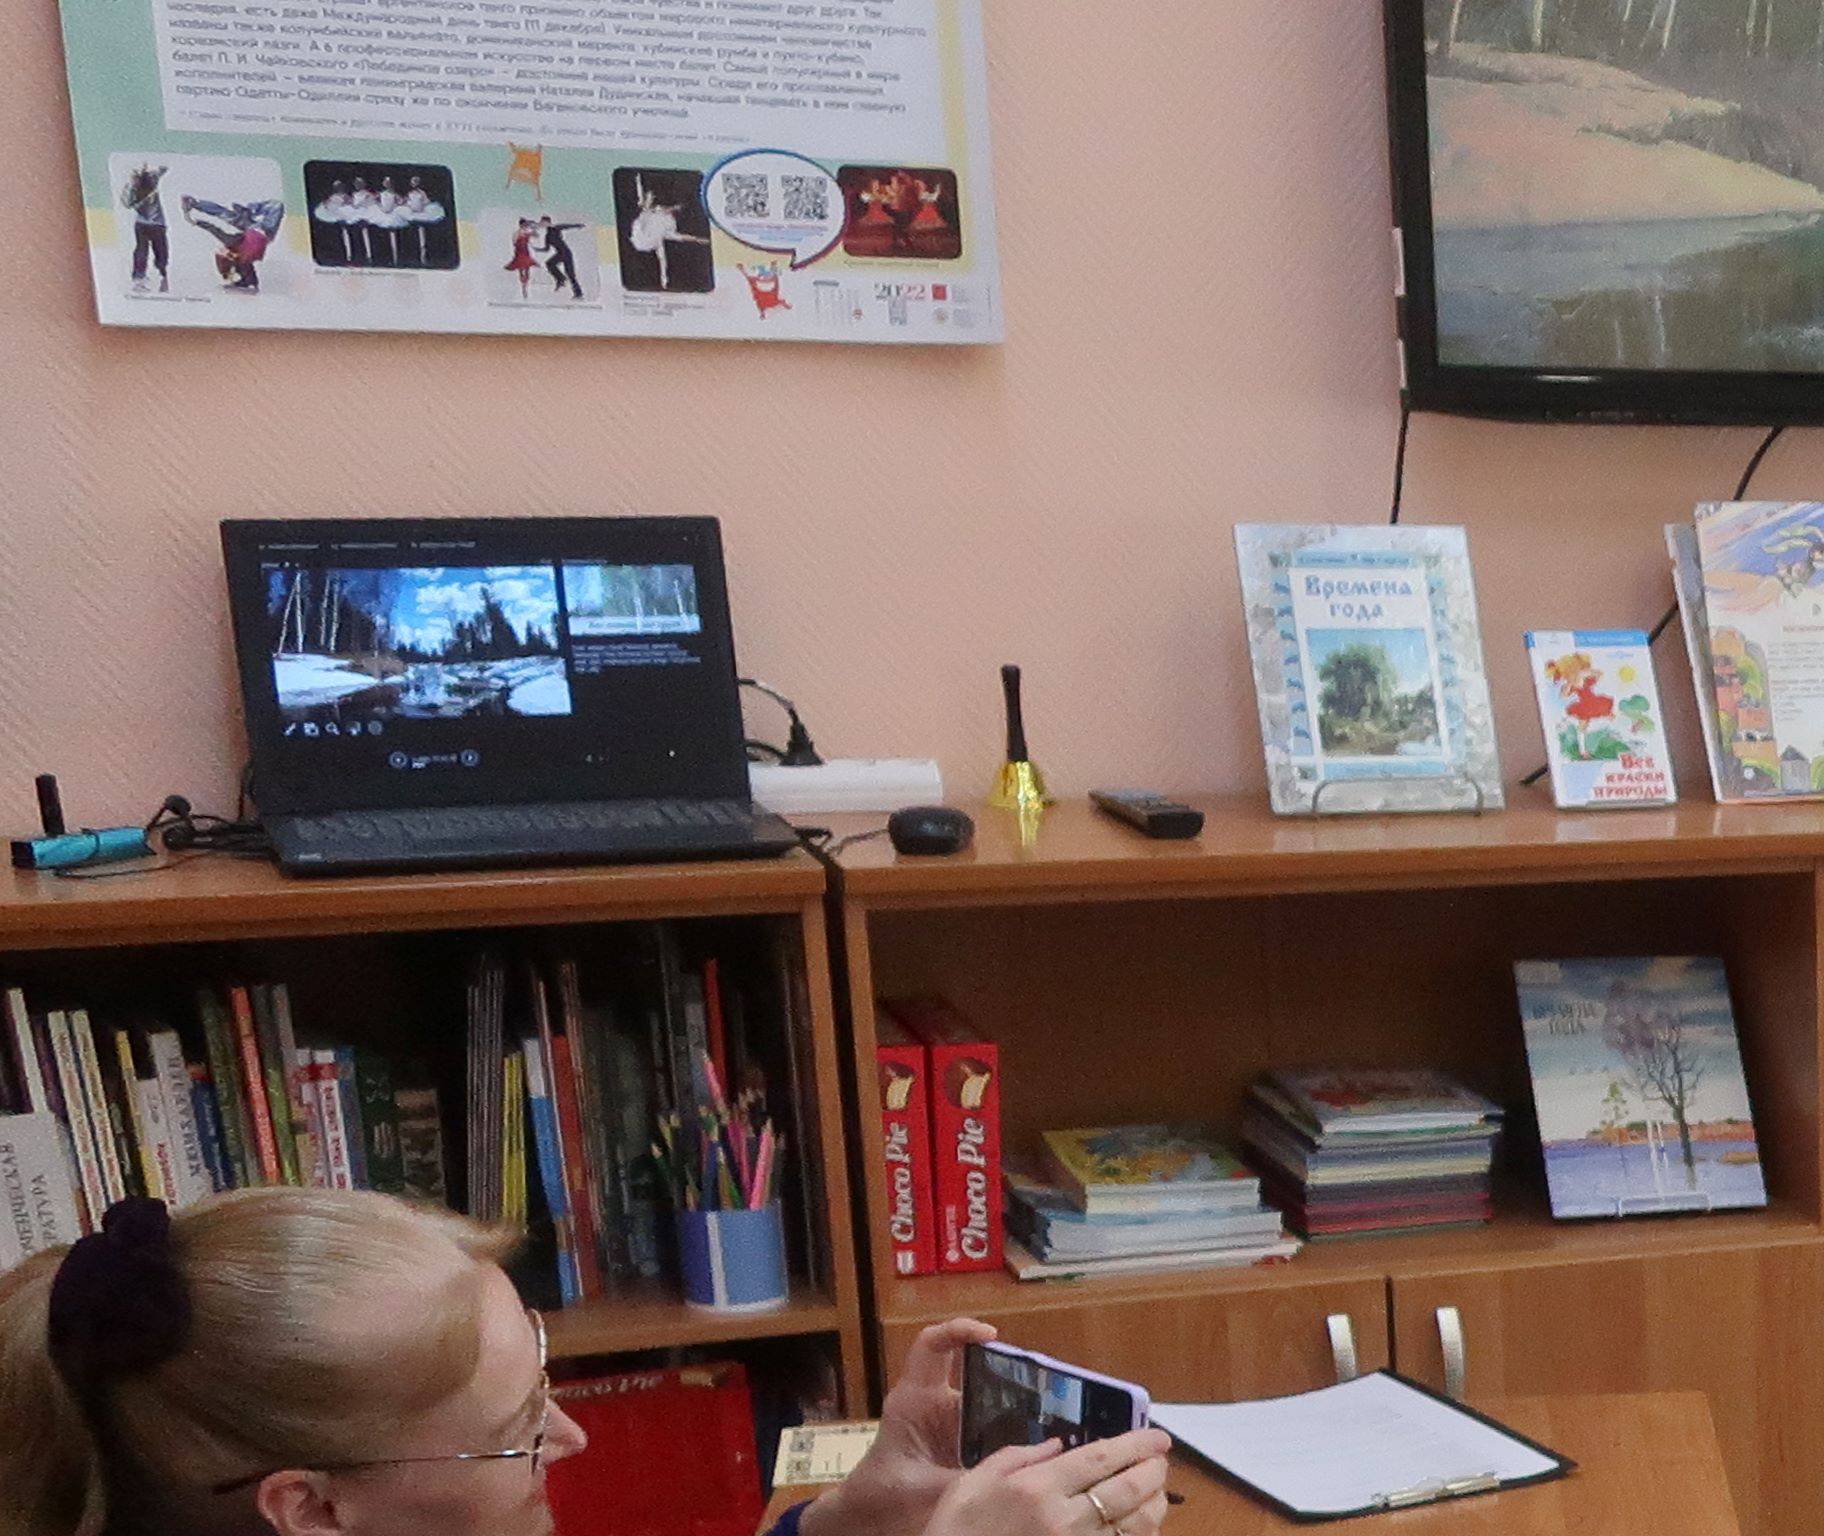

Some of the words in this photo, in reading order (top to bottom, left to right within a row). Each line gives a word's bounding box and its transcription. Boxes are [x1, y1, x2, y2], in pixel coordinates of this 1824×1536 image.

[875, 283, 926, 300] 2022
[1305, 575, 1412, 599] Времена
[1330, 603, 1383, 621] года
[885, 1122, 912, 1164] Pie
[957, 1117, 987, 1167] Pie
[890, 1167, 915, 1243] Choco
[961, 1170, 989, 1260] Choco
